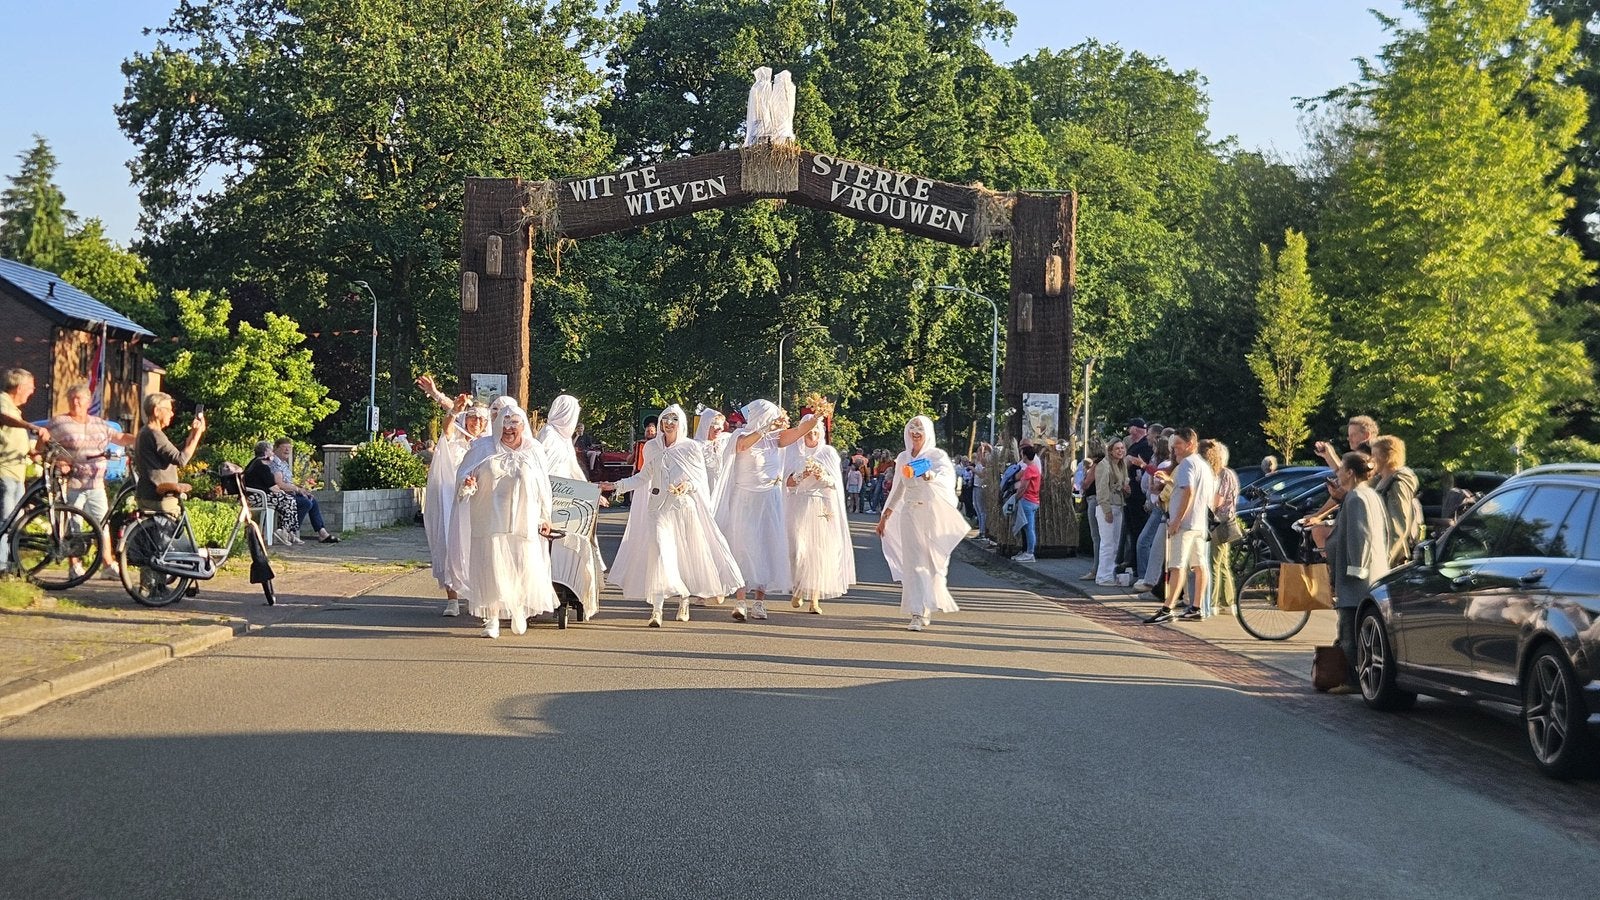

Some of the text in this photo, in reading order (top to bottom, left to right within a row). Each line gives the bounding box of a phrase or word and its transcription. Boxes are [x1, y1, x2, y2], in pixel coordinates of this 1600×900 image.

[568, 166, 661, 202] WITTE
[624, 175, 727, 217] WIEVEN
[811, 154, 934, 201] STERKE
[830, 180, 969, 234] VROUWEN
